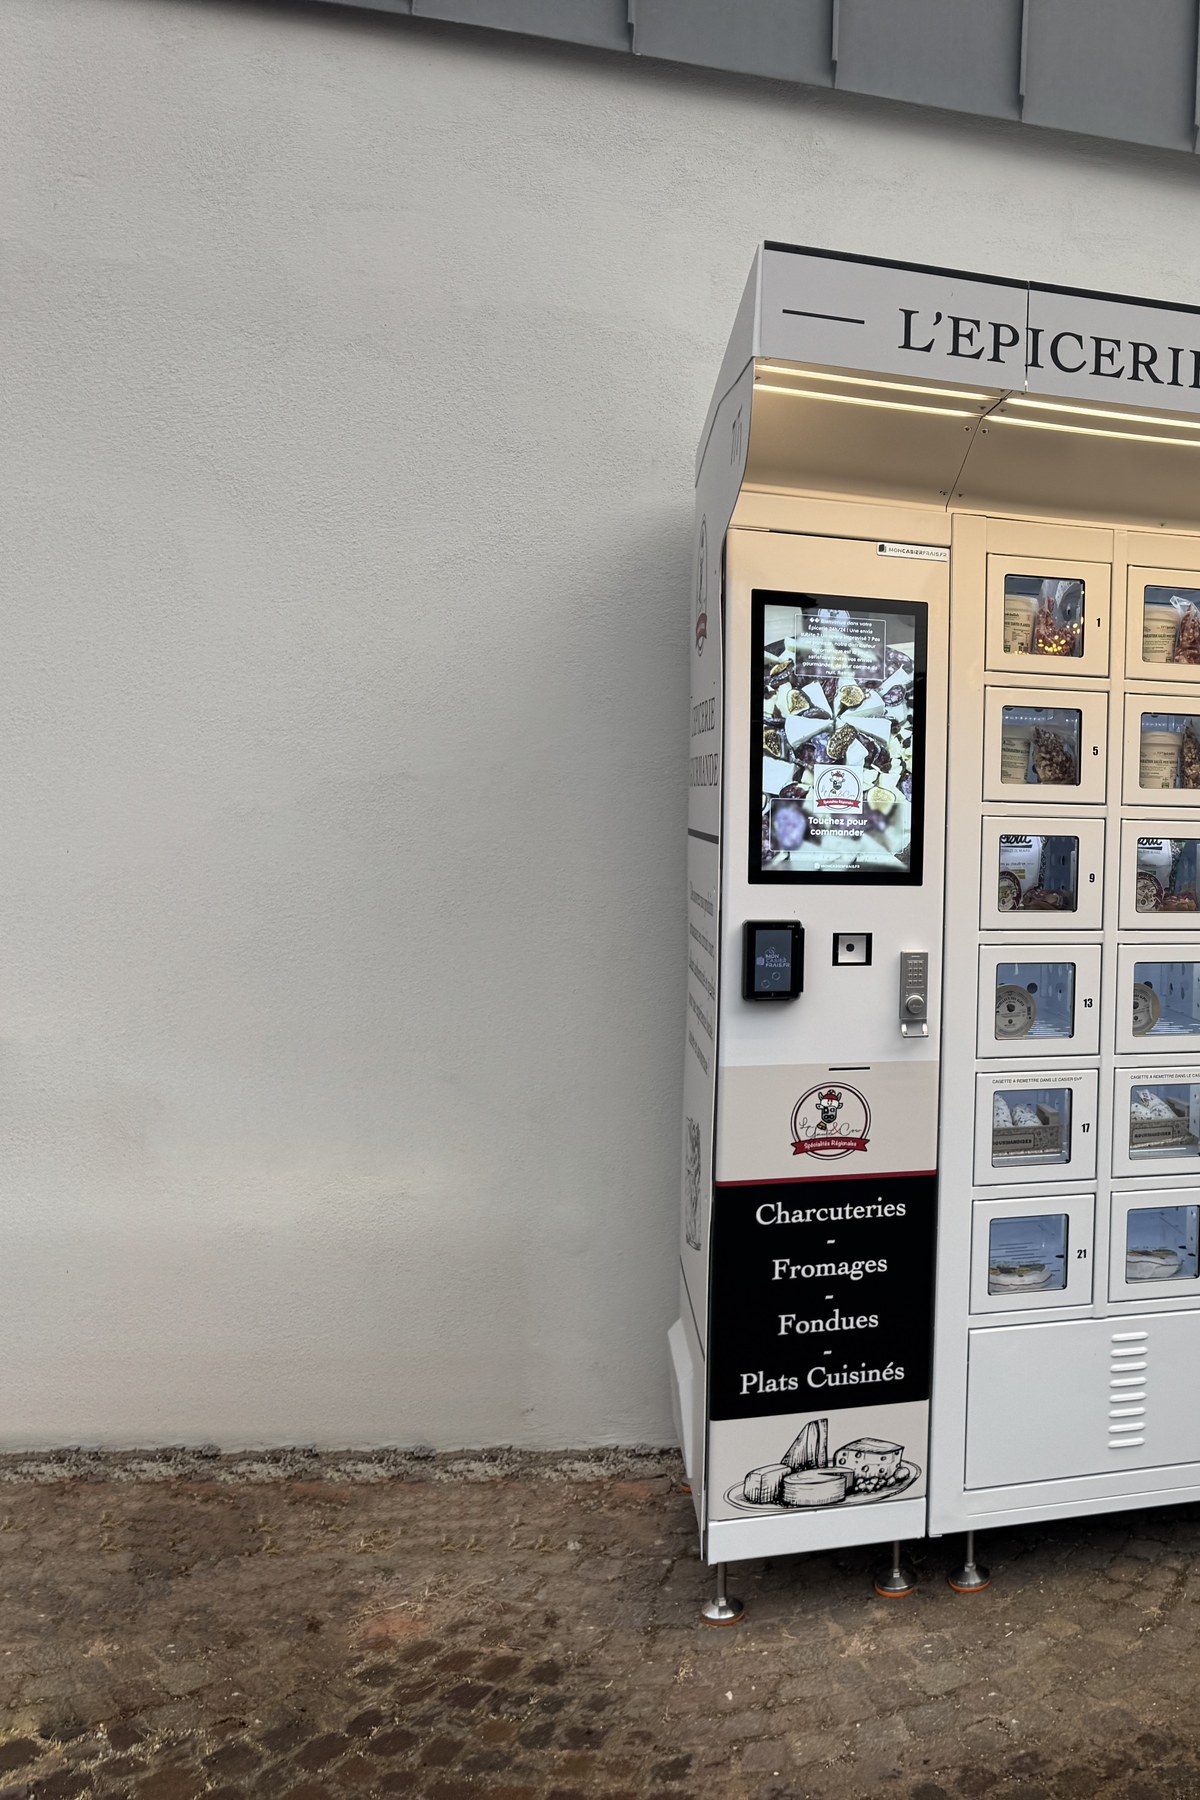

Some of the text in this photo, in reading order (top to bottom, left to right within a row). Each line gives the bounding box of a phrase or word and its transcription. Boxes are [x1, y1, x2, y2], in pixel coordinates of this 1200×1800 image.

[1096, 618, 1101, 628] 1
[1092, 746, 1099, 756] 5
[808, 816, 868, 827] Touchez pour
[810, 828, 864, 836] commander.
[1089, 873, 1095, 883] 9
[1083, 998, 1093, 1008] 13
[1081, 1123, 1090, 1133] 17
[804, 1140, 830, 1149] Spécialités
[756, 1196, 906, 1225] Charcuteries
[1076, 1248, 1087, 1259] 21
[772, 1258, 888, 1281] Fromages
[777, 1308, 879, 1336] Fondues
[739, 1362, 905, 1395] Plats Cuisinés
